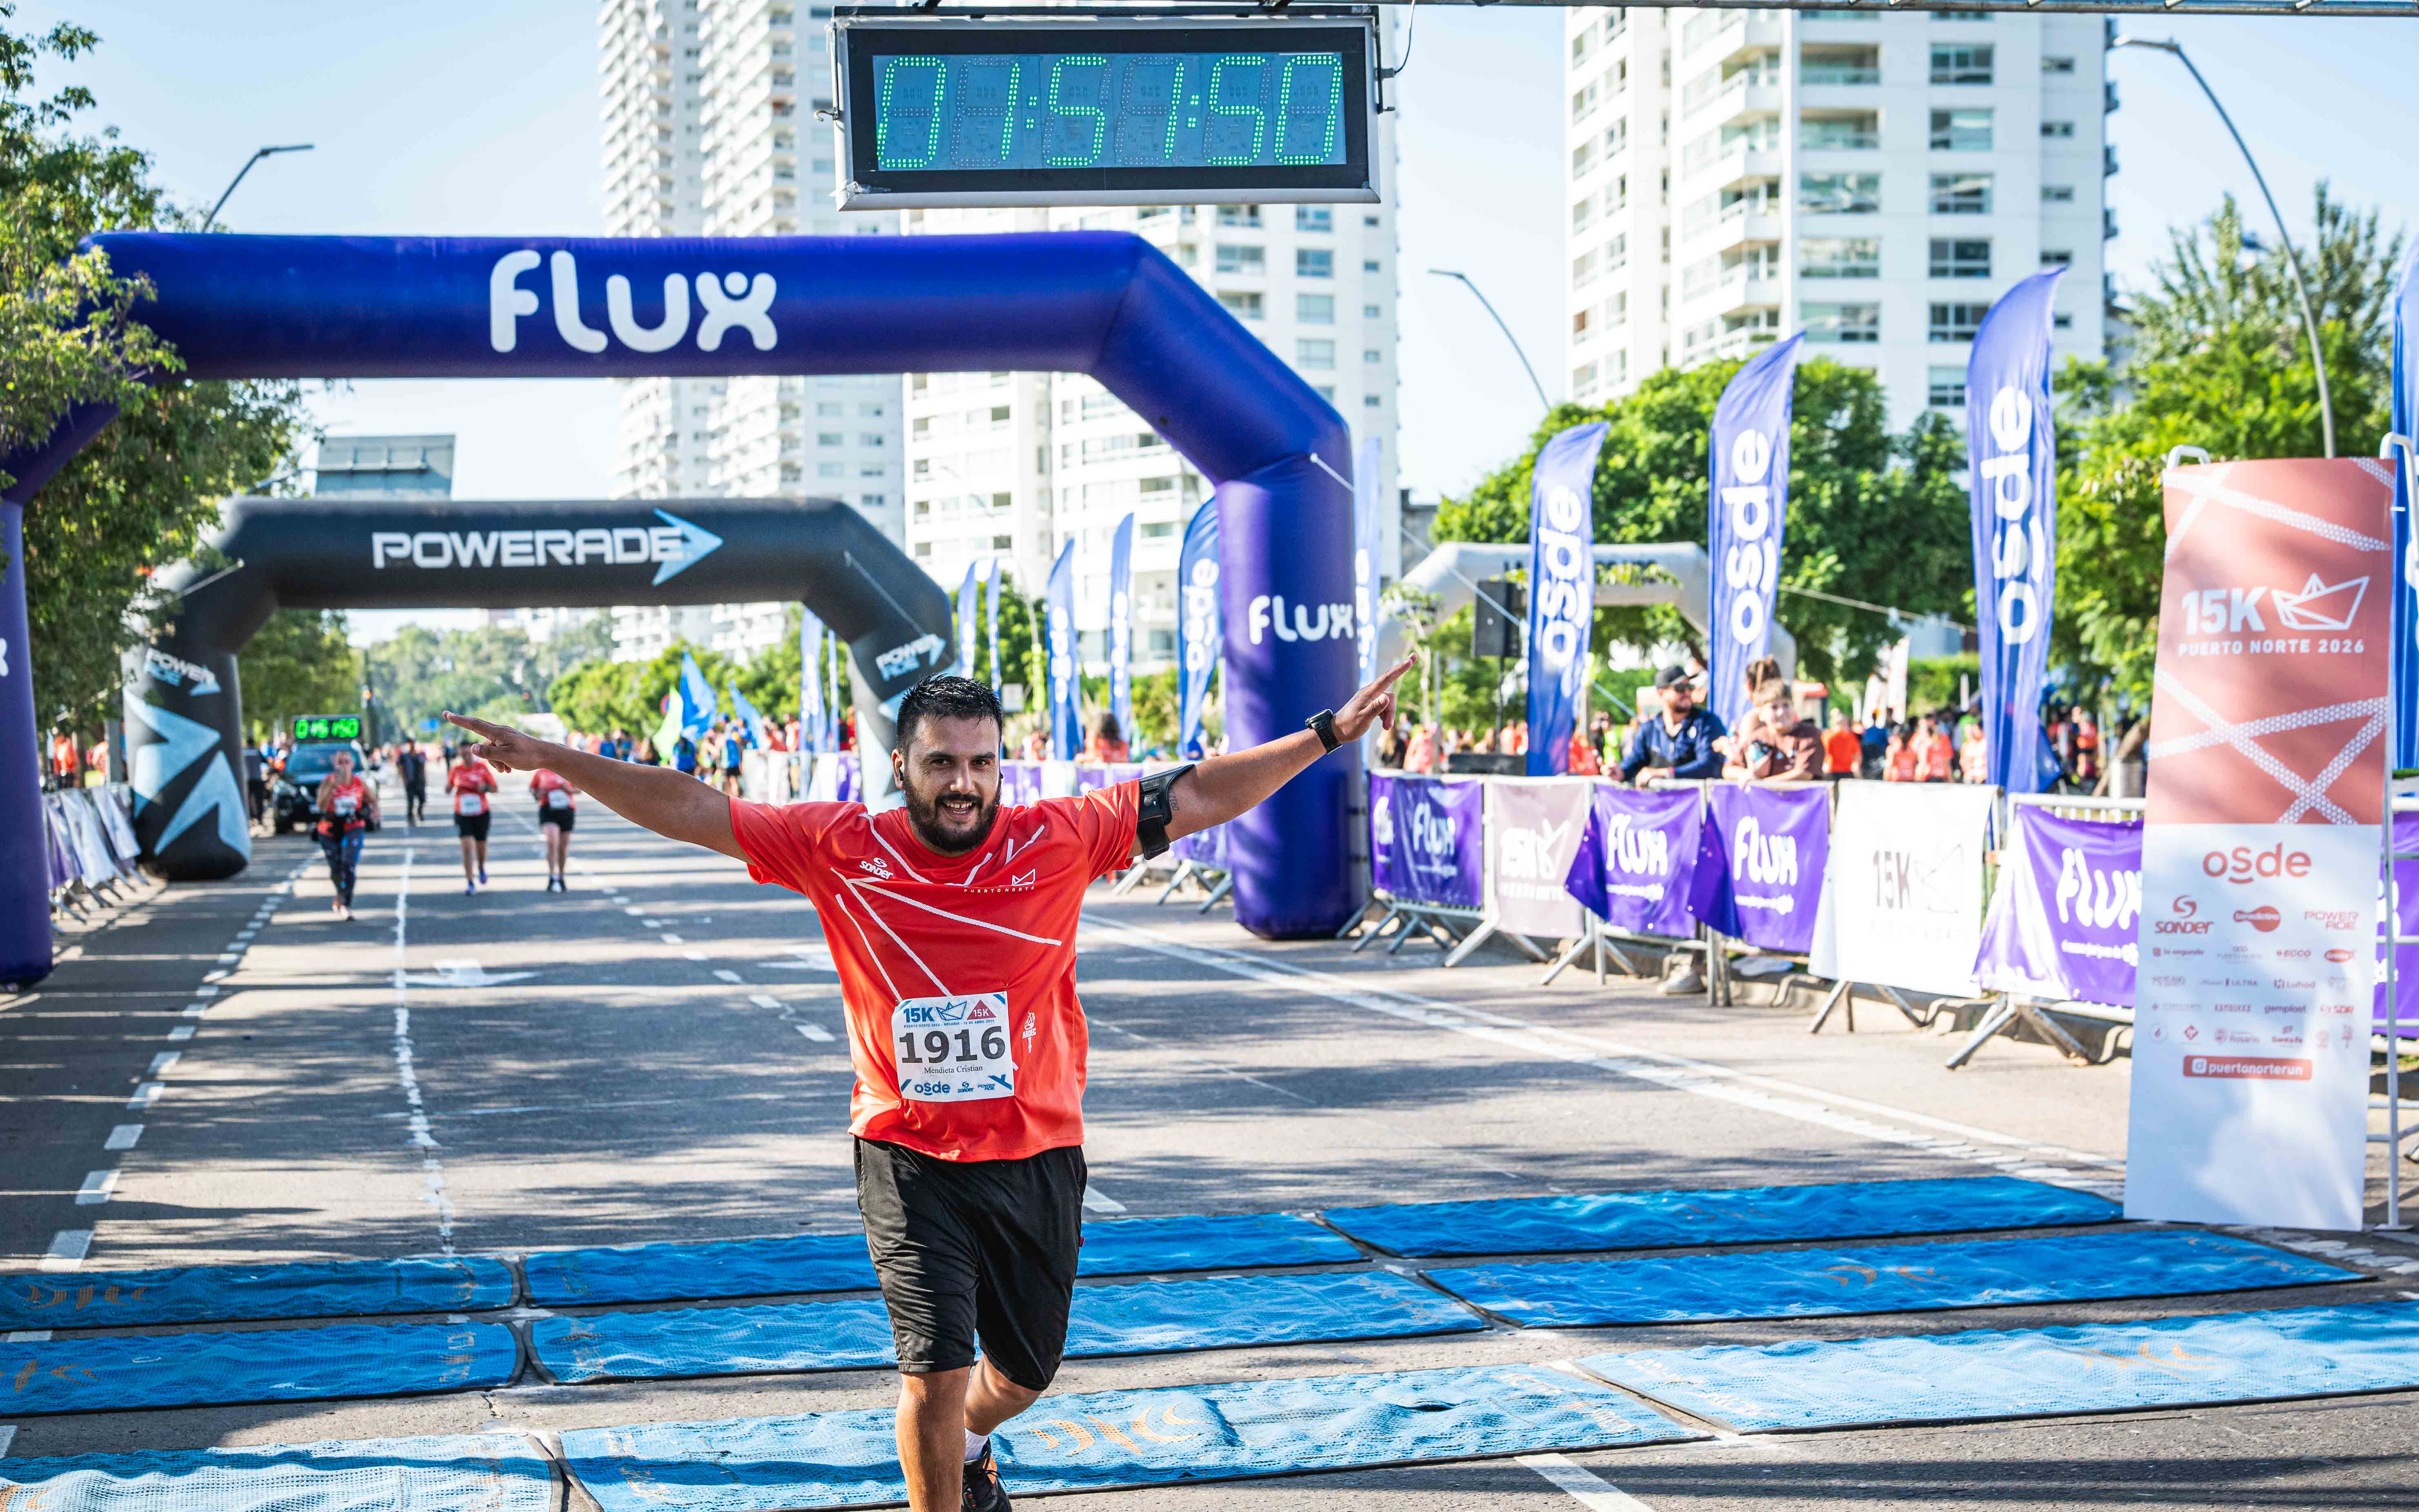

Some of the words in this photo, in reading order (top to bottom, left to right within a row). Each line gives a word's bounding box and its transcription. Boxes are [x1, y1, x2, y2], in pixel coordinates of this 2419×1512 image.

[876, 56, 1342, 167] 01:51:50
[1981, 386, 2041, 645] osde
[372, 527, 682, 569] POWERADE
[1722, 429, 1775, 645] osde
[1538, 484, 1590, 667] osde
[2182, 586, 2267, 635] 15K
[2179, 641, 2242, 656] PUERTO
[2250, 639, 2309, 654] NORTE
[2319, 639, 2364, 653] 2026
[1873, 850, 1910, 909] 15K
[2203, 841, 2311, 881] osde
[2304, 911, 2359, 921] POWER
[903, 1007, 934, 1023] 15K
[973, 1008, 989, 1017] 15K
[899, 1026, 1006, 1064] 1916
[914, 1081, 950, 1095] osde
[2208, 1063, 2303, 1075] puertonorterun
